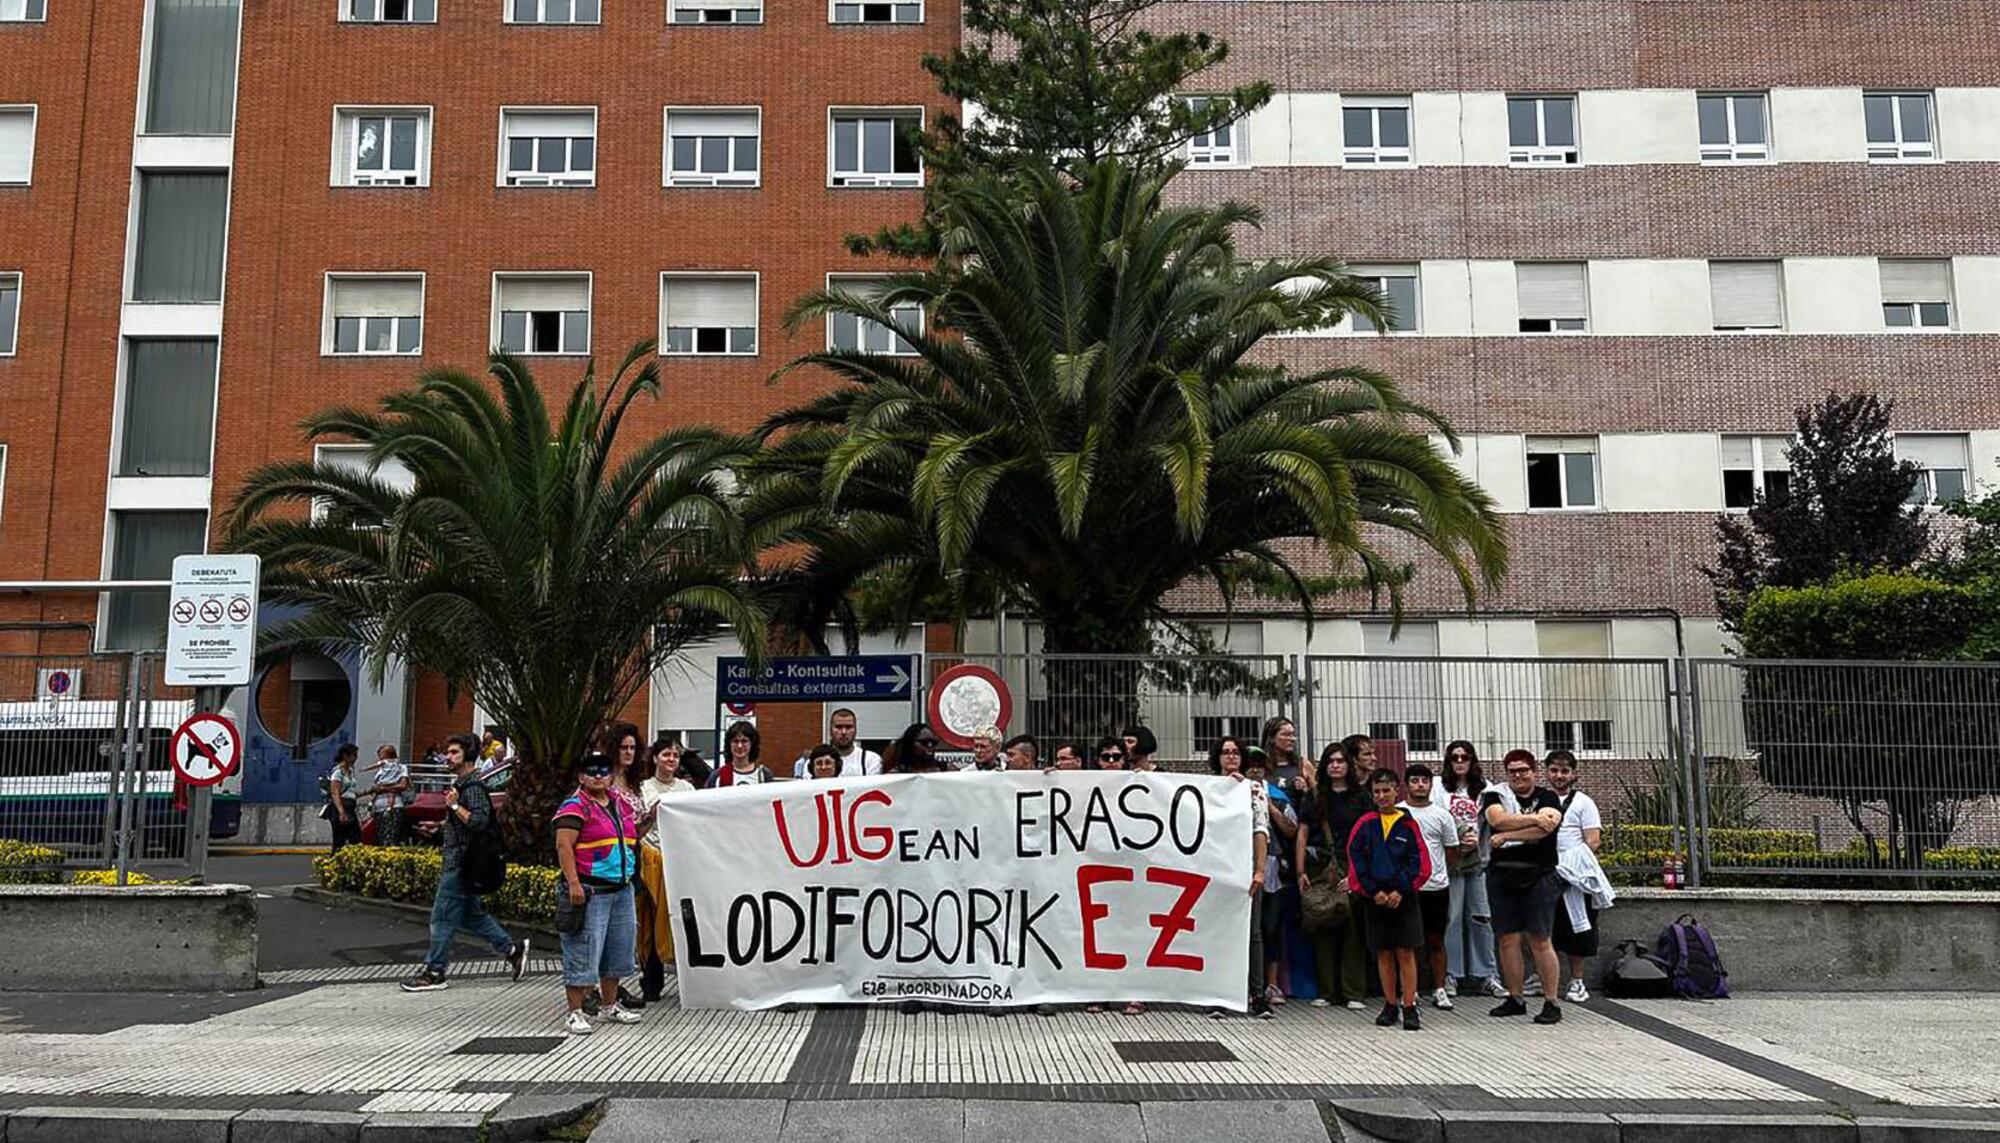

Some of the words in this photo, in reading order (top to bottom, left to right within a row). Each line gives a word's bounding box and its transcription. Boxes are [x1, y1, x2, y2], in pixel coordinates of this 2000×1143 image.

[727, 665, 774, 678] Kao
[787, 664, 865, 678] Kontsultak
[727, 681, 799, 695] Consultas
[803, 682, 865, 694] externas
[1016, 784, 1205, 858] ERASO
[680, 885, 1063, 971] LODIFOBORIK
[1076, 865, 1212, 972] EZ
[861, 981, 887, 996] E28
[897, 981, 1013, 1000] KOORDINADORA
